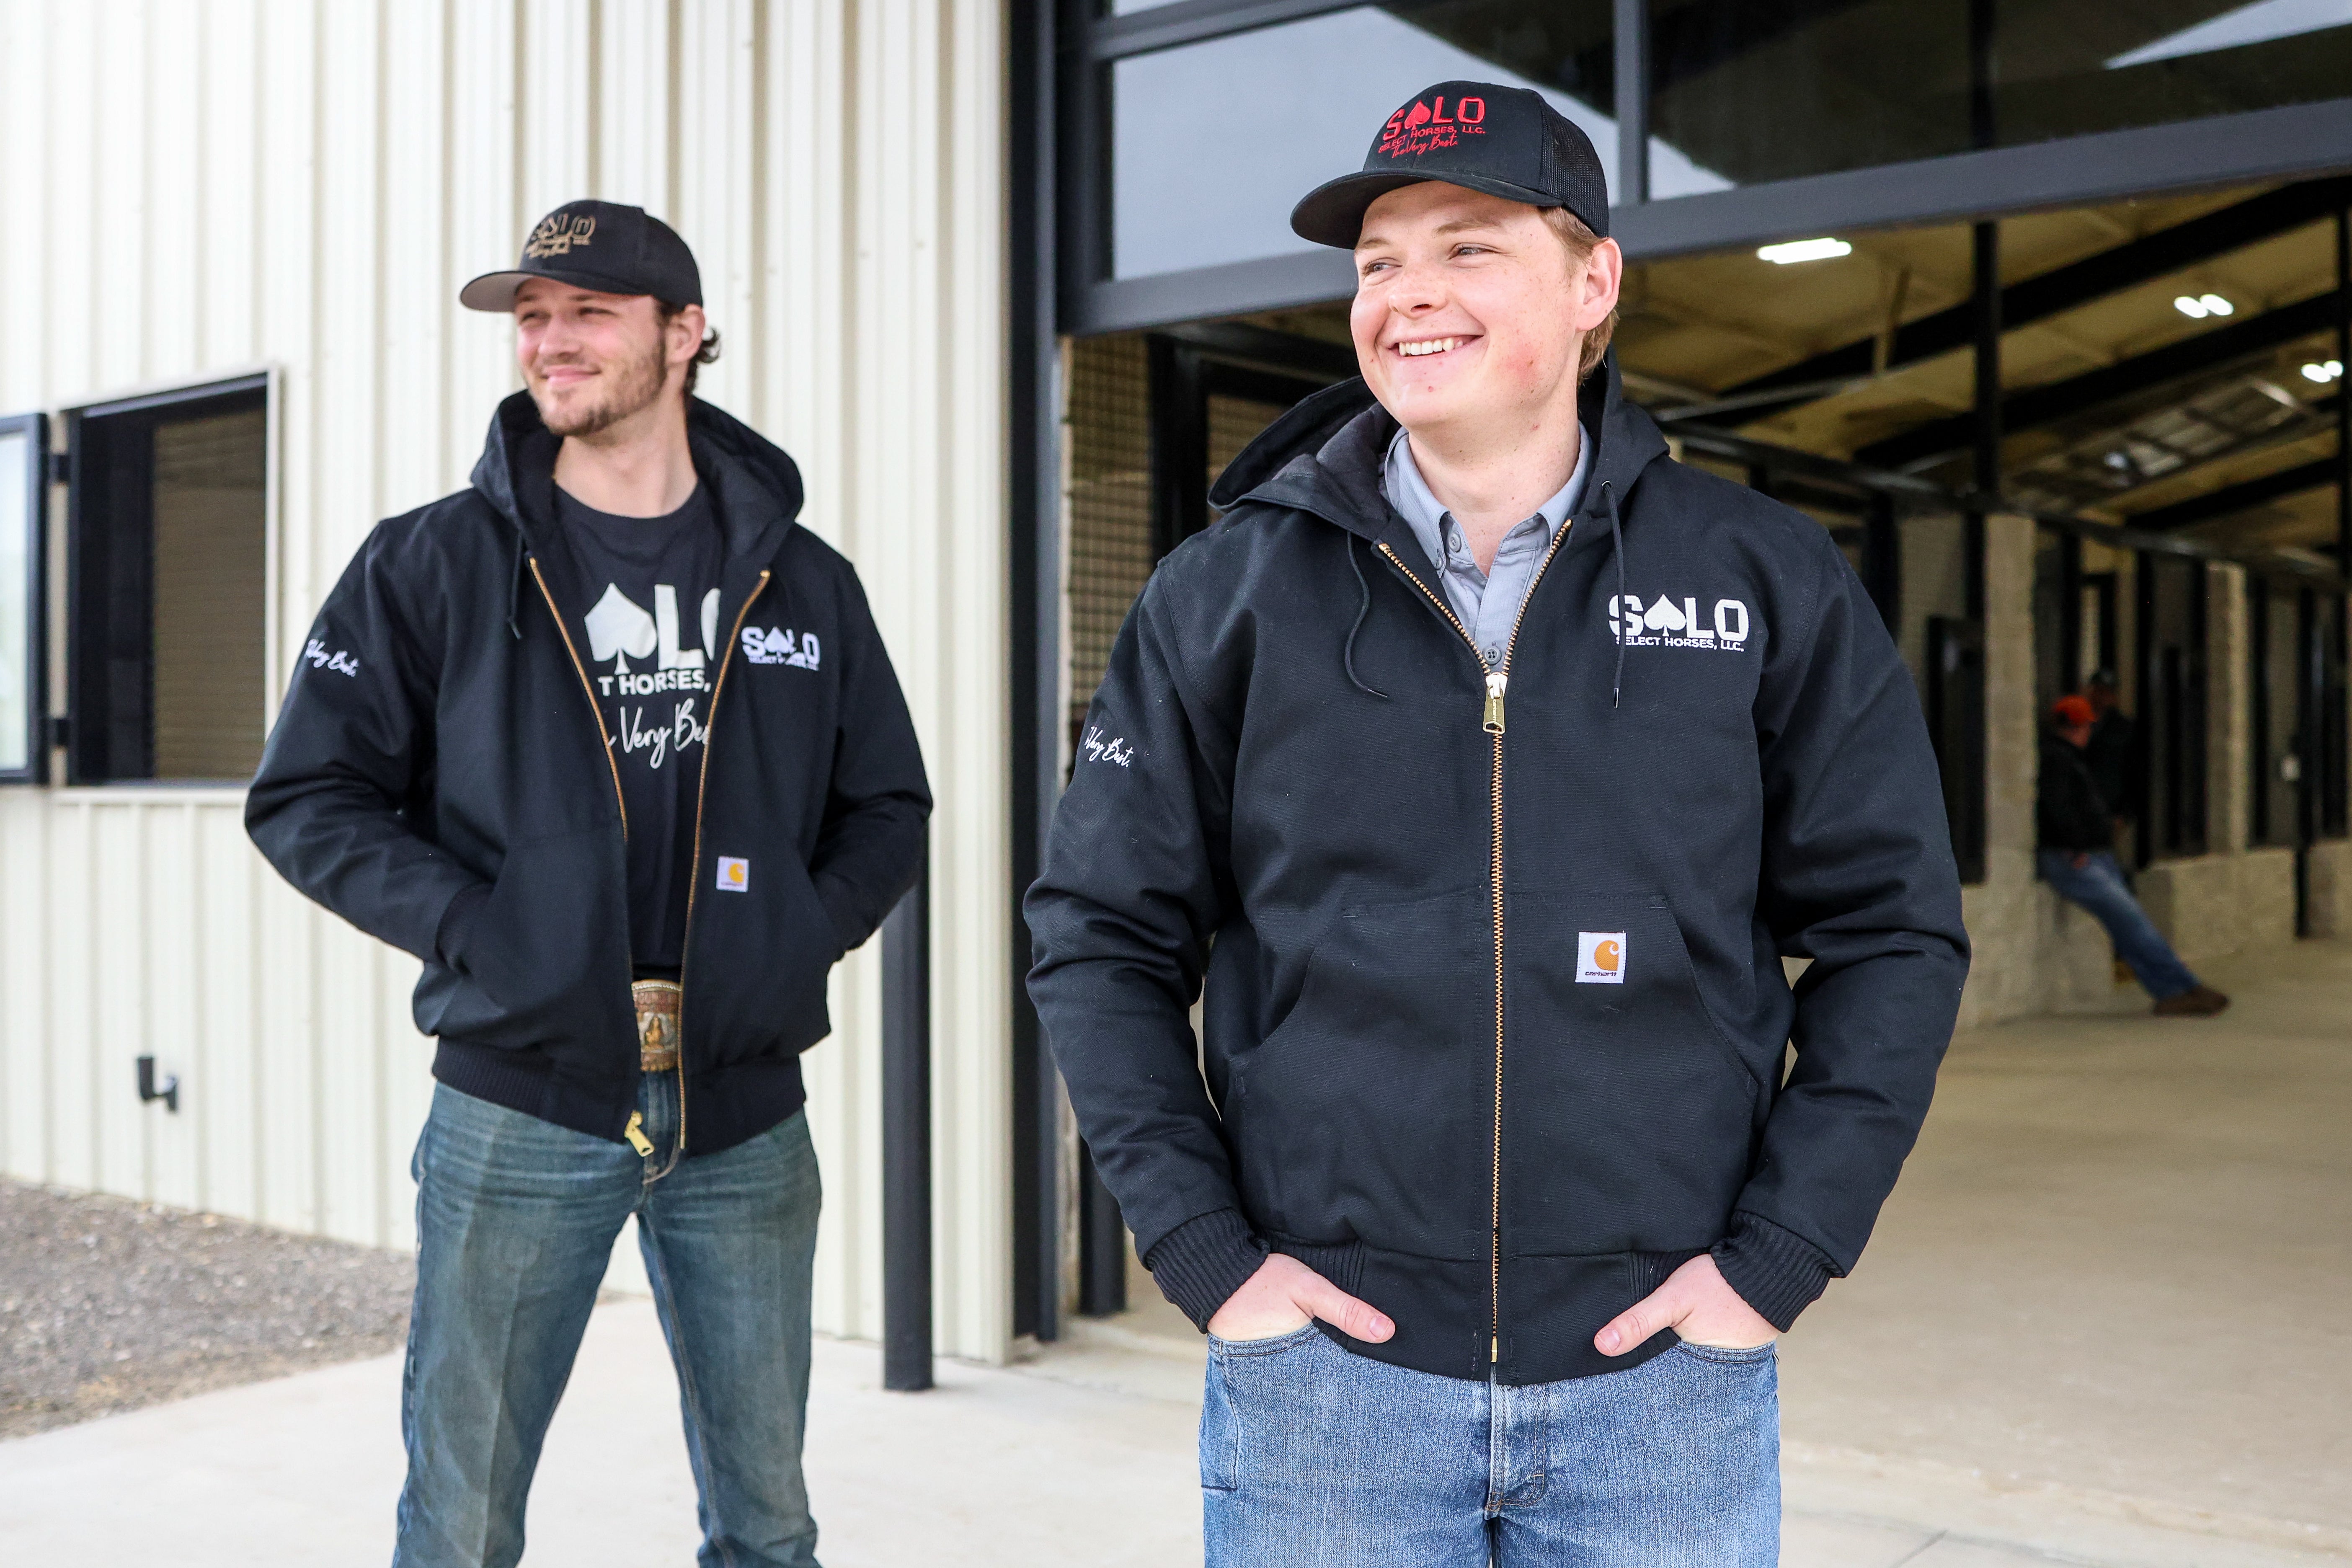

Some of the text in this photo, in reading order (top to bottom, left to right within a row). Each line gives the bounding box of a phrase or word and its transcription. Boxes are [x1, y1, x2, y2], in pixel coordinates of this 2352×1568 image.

[1406, 137, 1429, 155] Very
[1664, 637, 1718, 650] HORSES,
[1720, 639, 1745, 652] LLC.
[618, 670, 712, 696] HORSES,
[620, 706, 673, 769] Very
[1102, 737, 1134, 768] Best.
